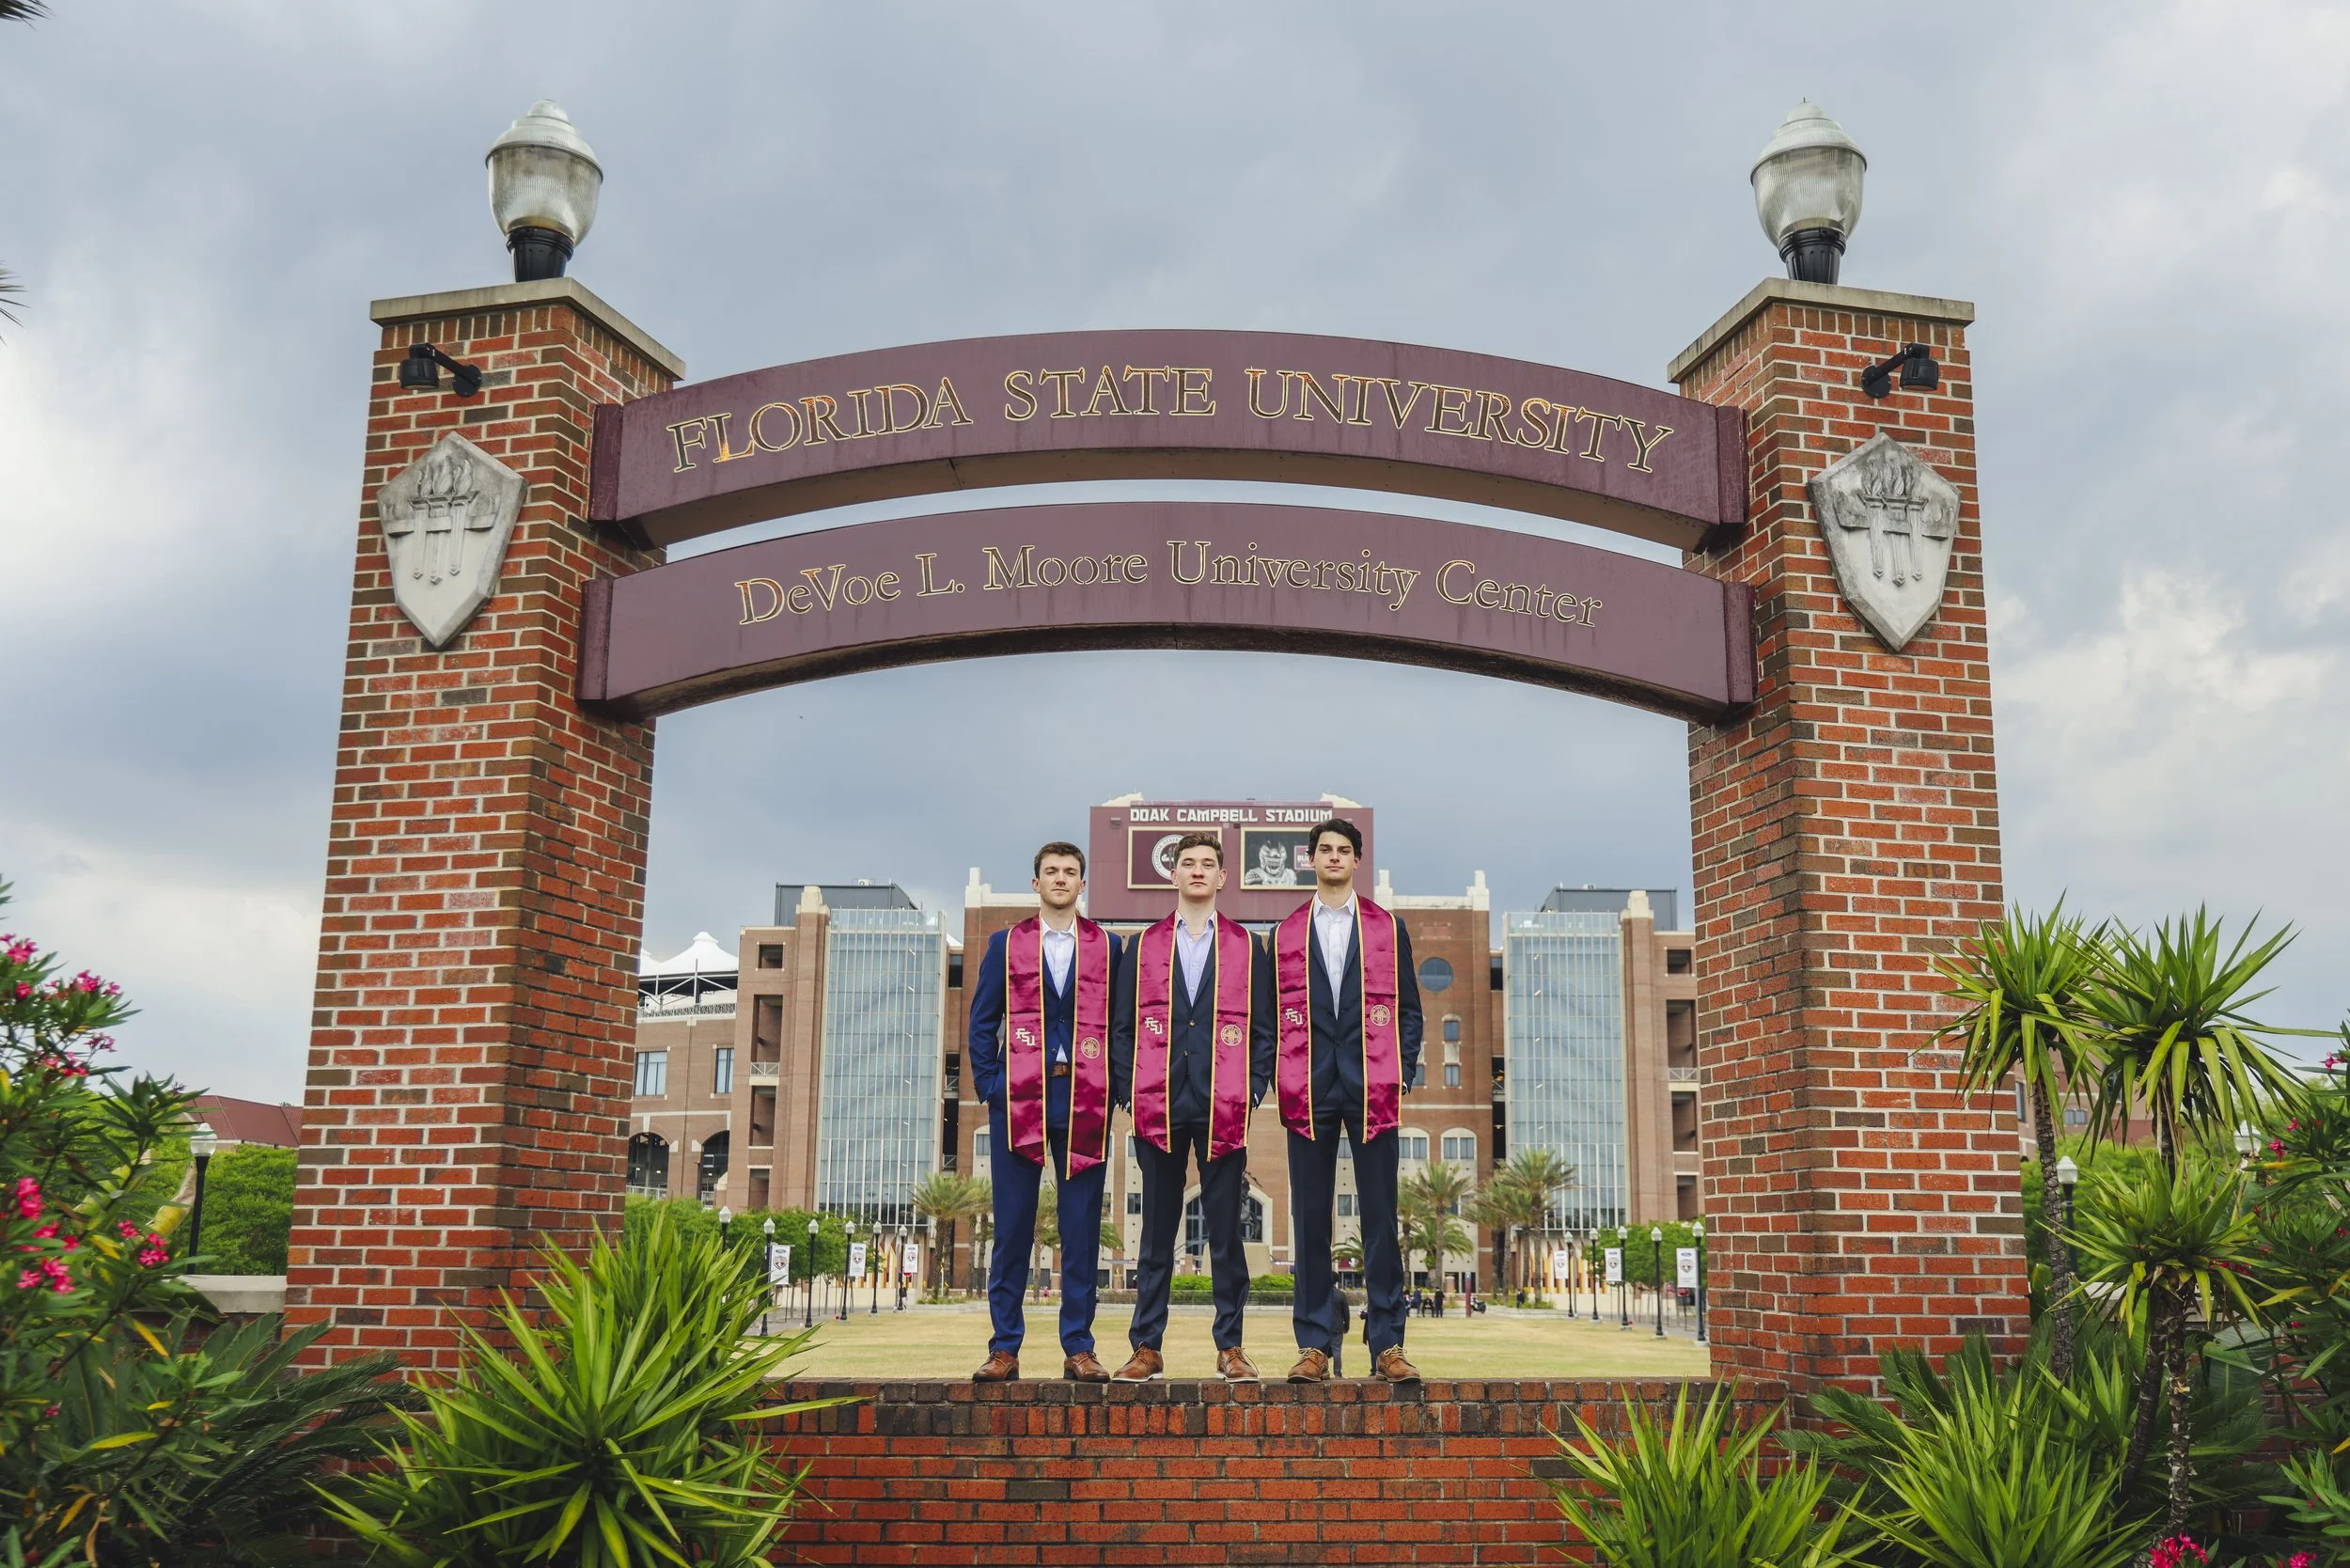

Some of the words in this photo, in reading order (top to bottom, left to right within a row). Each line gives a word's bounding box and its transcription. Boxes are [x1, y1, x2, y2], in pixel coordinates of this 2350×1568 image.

[666, 376, 974, 473] FLORIDA
[1003, 365, 1217, 422] STATE
[1244, 366, 1674, 474] UNIVERSITY
[734, 563, 901, 625] DeVoe
[916, 553, 965, 597] L.
[982, 544, 1149, 591] Moore
[1167, 540, 1421, 612] University
[1434, 559, 1603, 628] Center
[1130, 808, 1170, 822] DOAK
[1177, 808, 1259, 823] CAMPBELL
[1265, 808, 1333, 823] STADIUM
[1144, 1016, 1163, 1035] FSU
[1285, 1008, 1304, 1026] FSU
[1015, 1027, 1036, 1046] FSU
